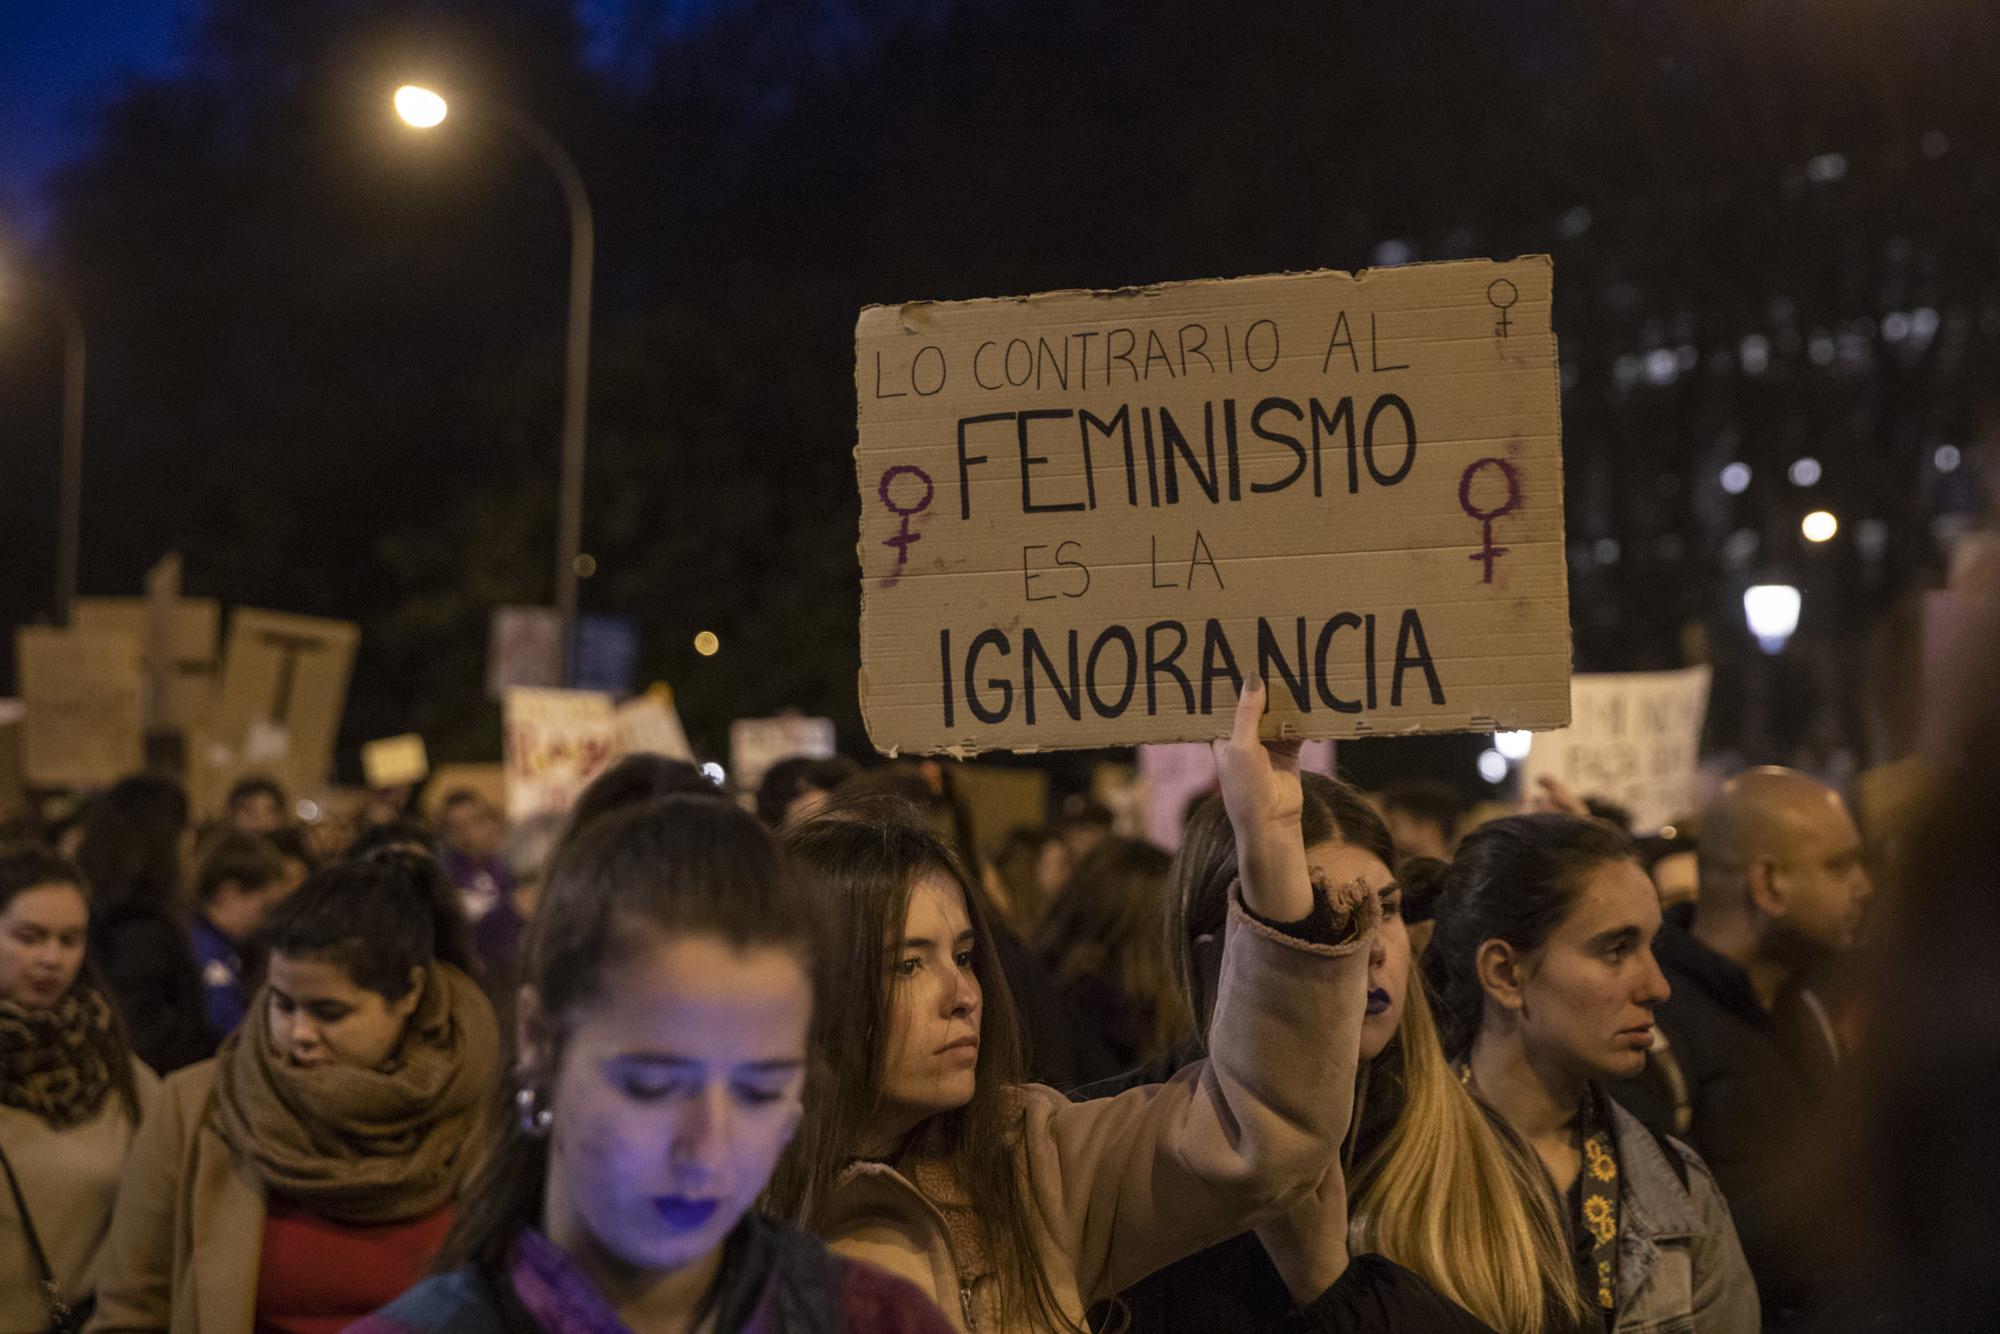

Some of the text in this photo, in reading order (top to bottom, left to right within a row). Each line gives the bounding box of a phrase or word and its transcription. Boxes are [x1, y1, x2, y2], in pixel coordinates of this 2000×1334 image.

[874, 310, 1410, 400] LO CONTRARIO AL
[956, 393, 1418, 520] FEMINISMO
[1023, 530, 1225, 601] ES LA
[940, 607, 1447, 728] IGNORANCIA
